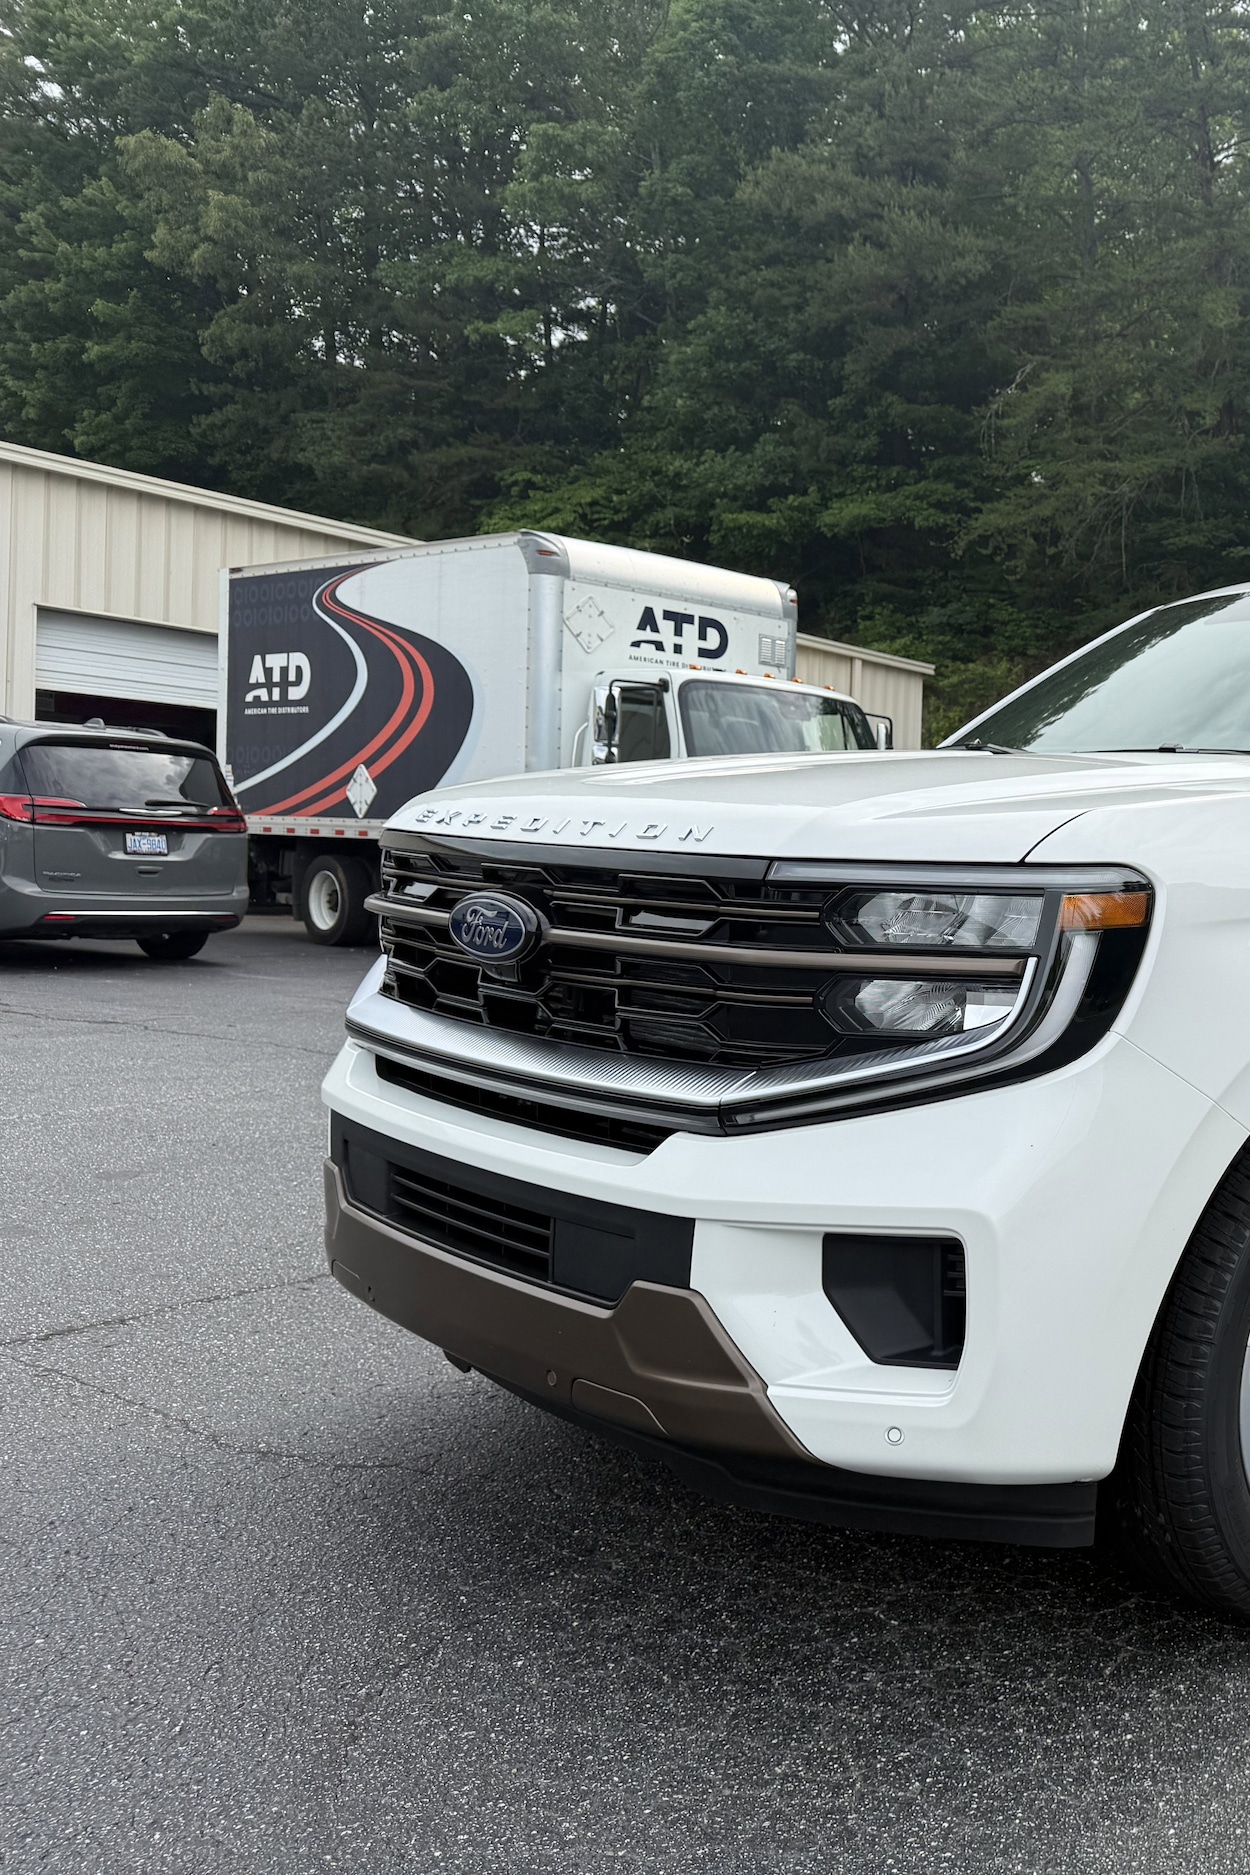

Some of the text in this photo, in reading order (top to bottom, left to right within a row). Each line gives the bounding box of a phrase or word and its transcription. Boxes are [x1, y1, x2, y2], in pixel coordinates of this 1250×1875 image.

[630, 606, 729, 659] ATD
[244, 652, 311, 702] ATD
[629, 654, 664, 665] AMERICAN
[666, 660, 680, 668] TIRE
[244, 705, 310, 715] AMERICAN TIRE DISTRIBUTORS
[415, 808, 714, 842] EXPEDITION
[461, 905, 509, 949] Ford
